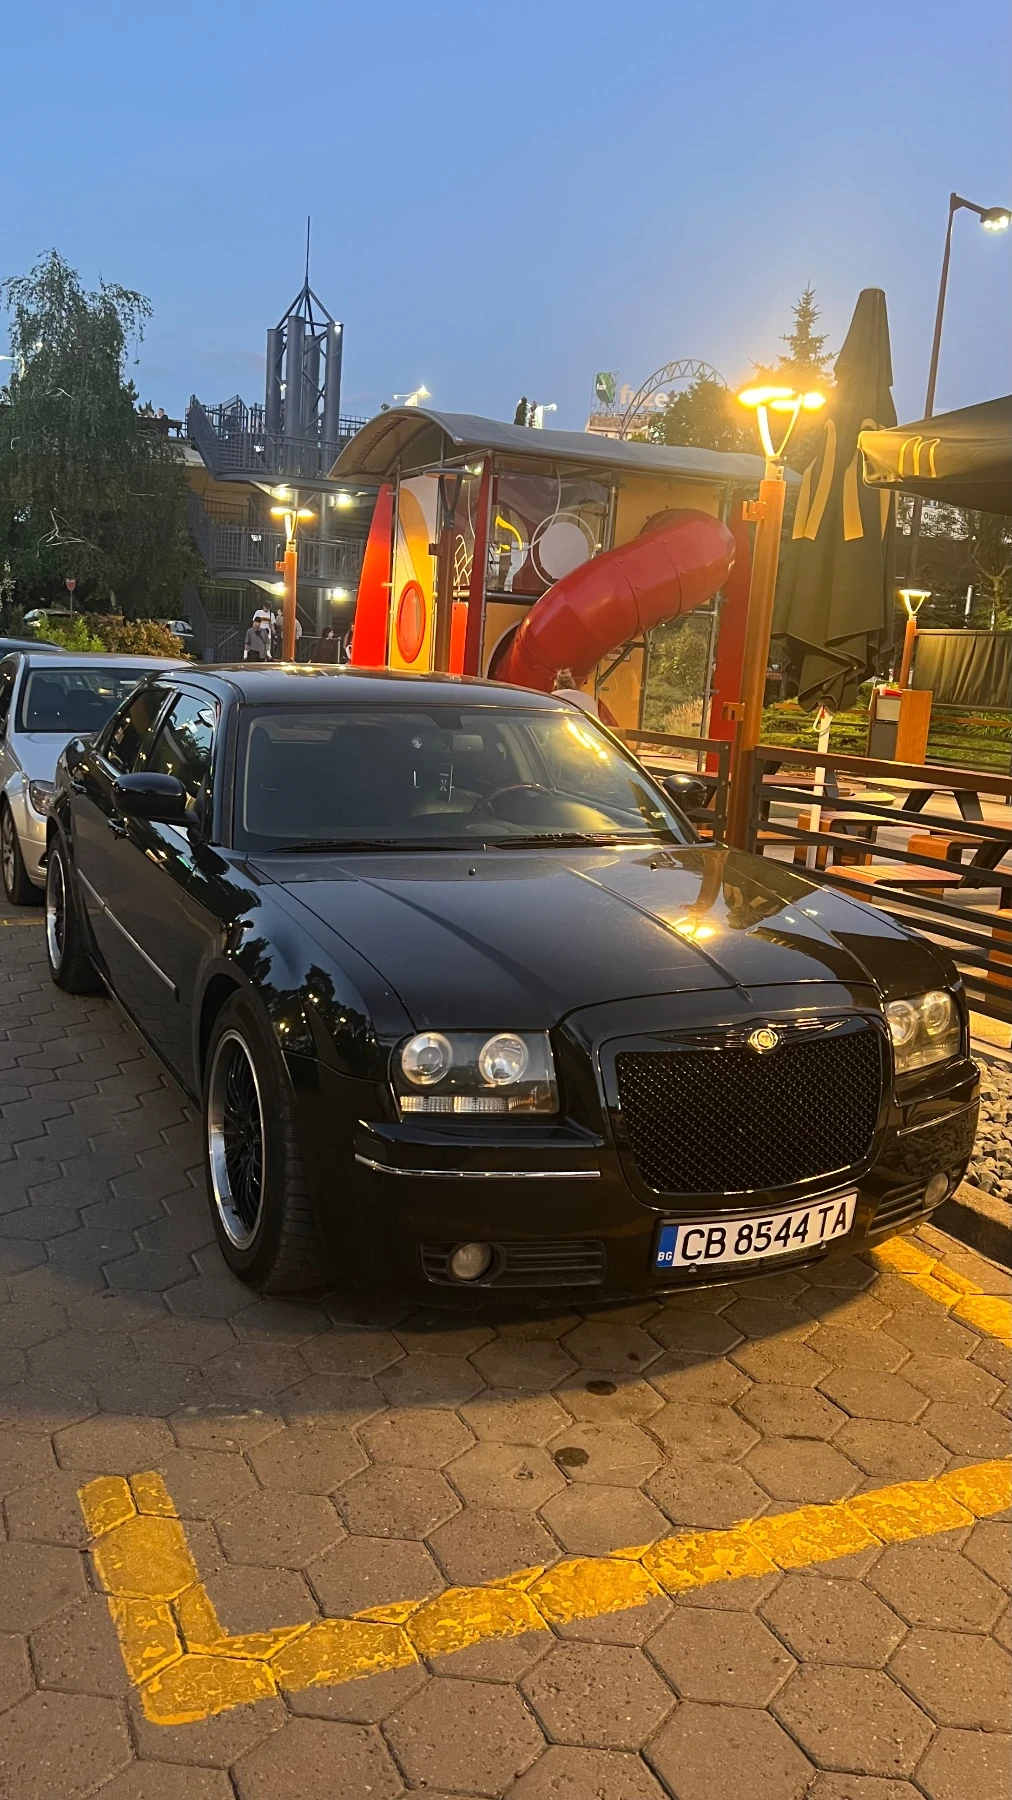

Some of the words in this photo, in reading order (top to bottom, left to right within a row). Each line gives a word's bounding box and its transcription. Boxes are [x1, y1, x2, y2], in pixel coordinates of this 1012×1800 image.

[681, 1227, 727, 1261] CB
[734, 1212, 811, 1255] 8544
[818, 1201, 847, 1238] TA
[657, 1251, 673, 1262] BG
